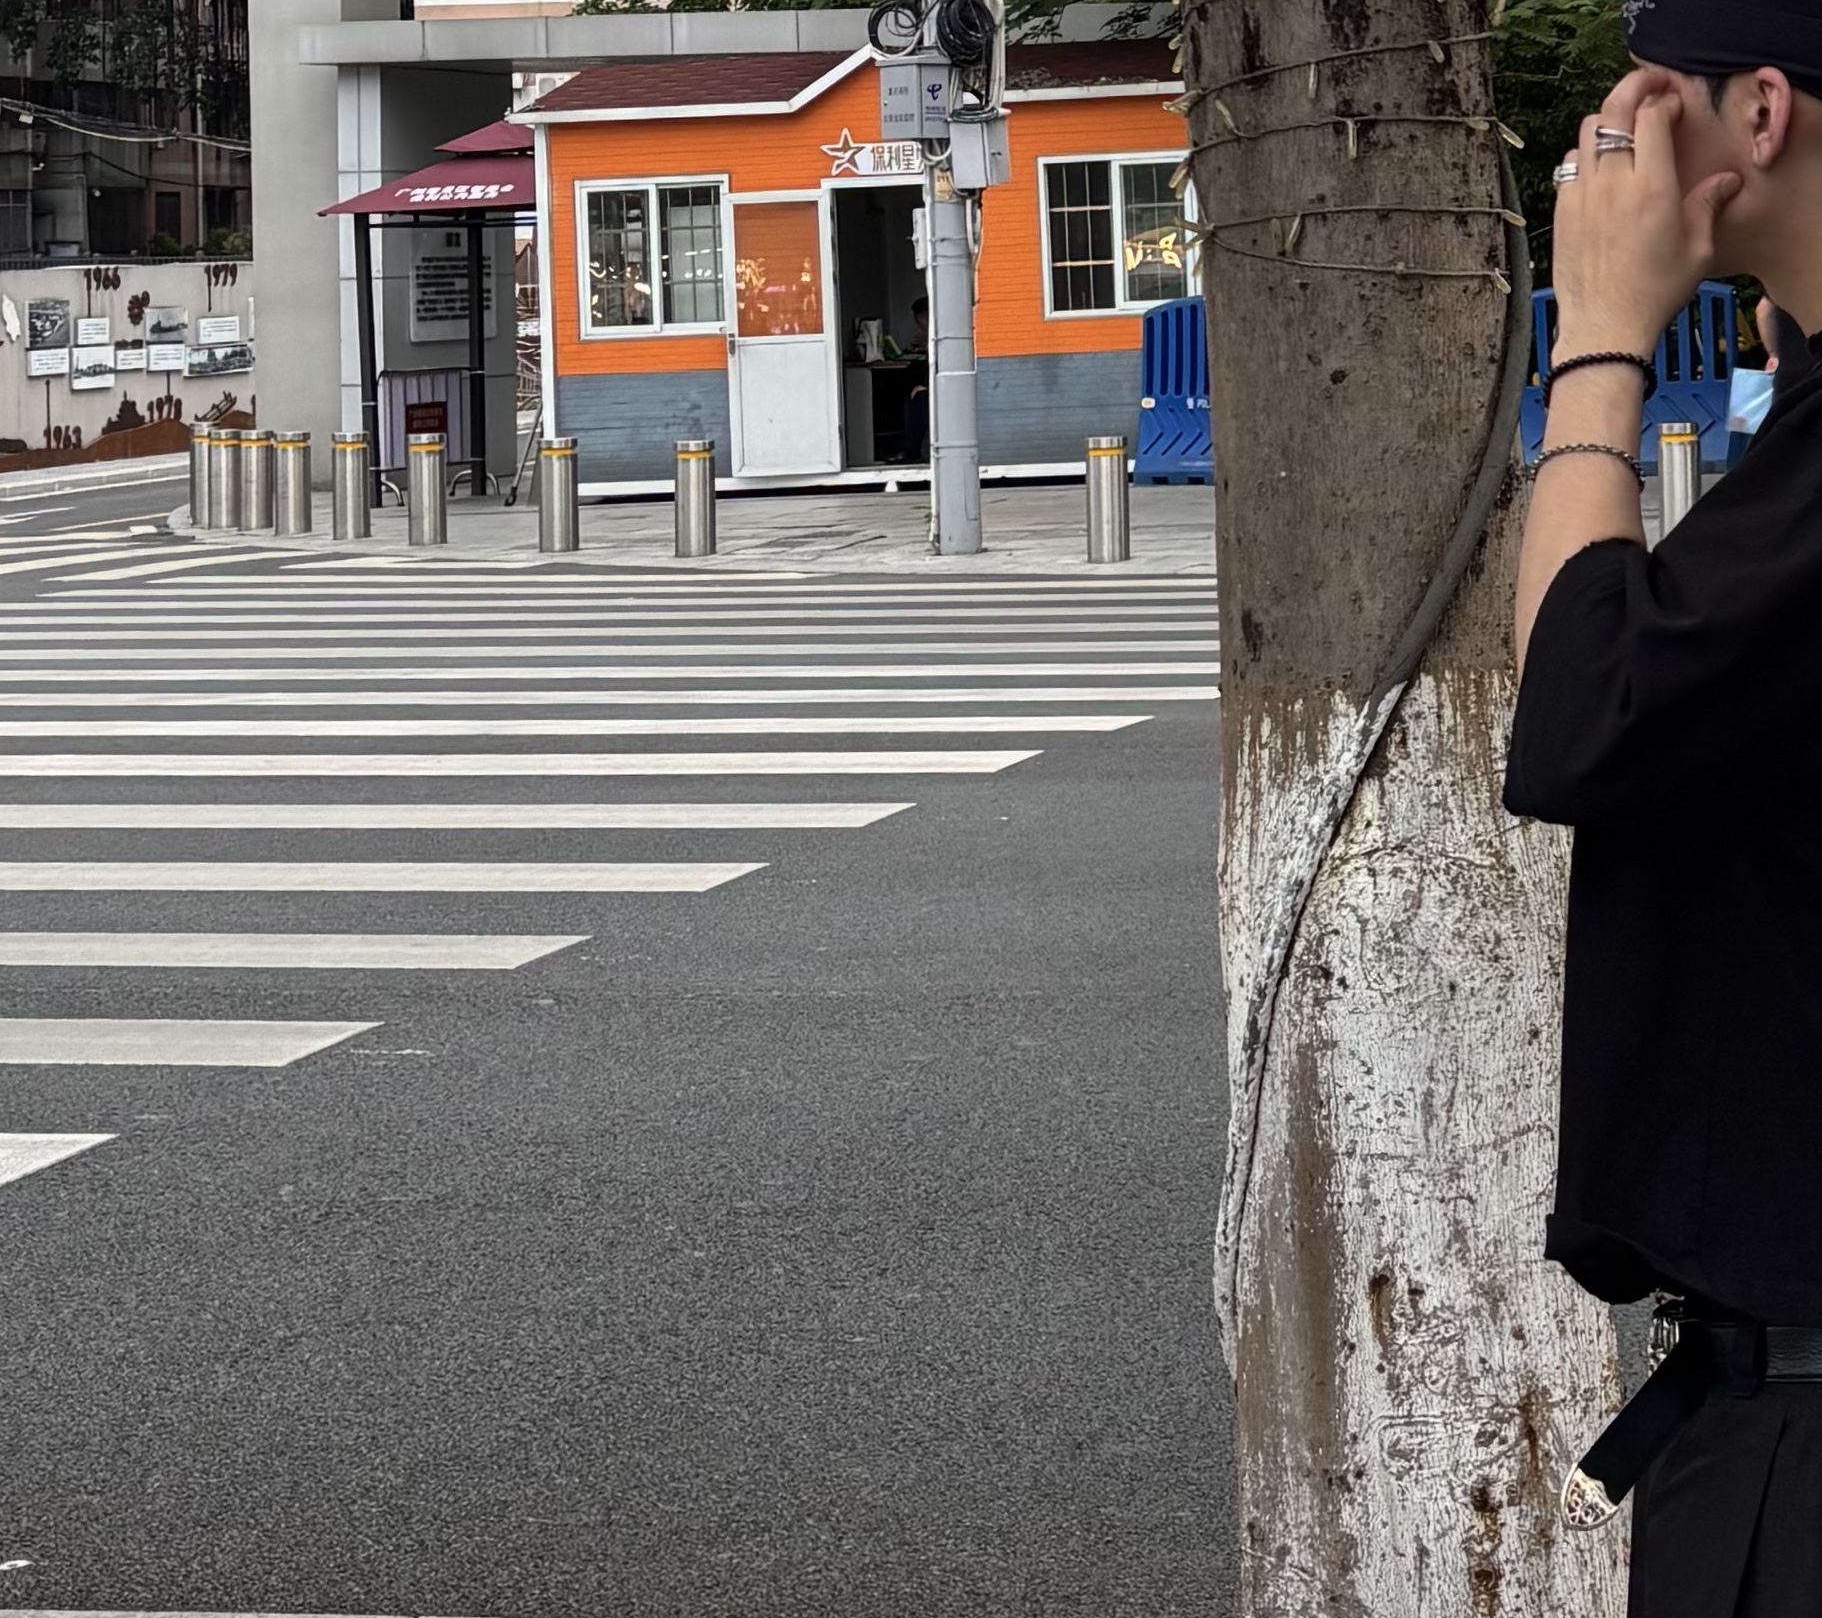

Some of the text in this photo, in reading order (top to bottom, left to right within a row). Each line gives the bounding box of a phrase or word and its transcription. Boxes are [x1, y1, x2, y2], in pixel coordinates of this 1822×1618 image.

[870, 144, 922, 173] 保利星
[84, 266, 121, 292] 1966
[204, 263, 238, 288] 1979
